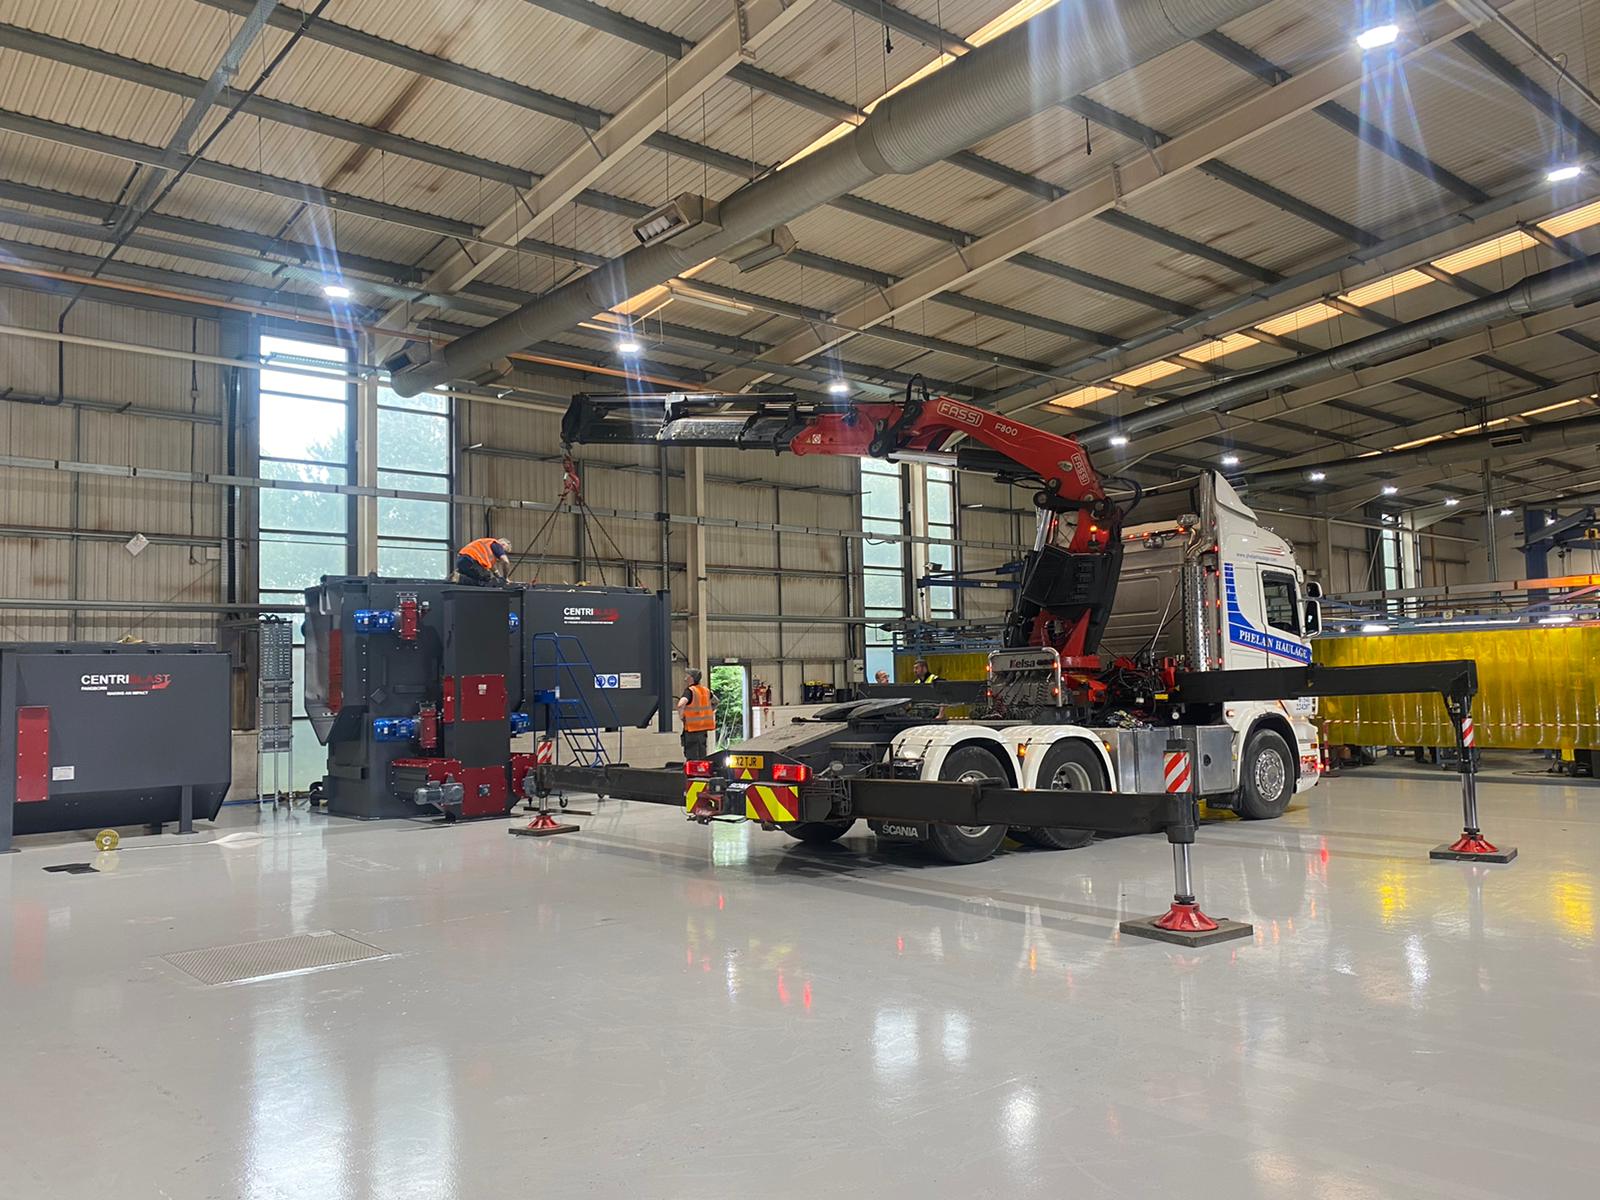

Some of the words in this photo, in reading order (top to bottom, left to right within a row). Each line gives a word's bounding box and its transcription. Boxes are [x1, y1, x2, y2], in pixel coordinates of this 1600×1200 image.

[940, 403, 980, 425] FASSI
[995, 422, 1018, 436] F800
[1239, 629, 1274, 648] PHELAN
[1275, 639, 1308, 659] HAULAGE
[882, 824, 919, 838] SCANIA
